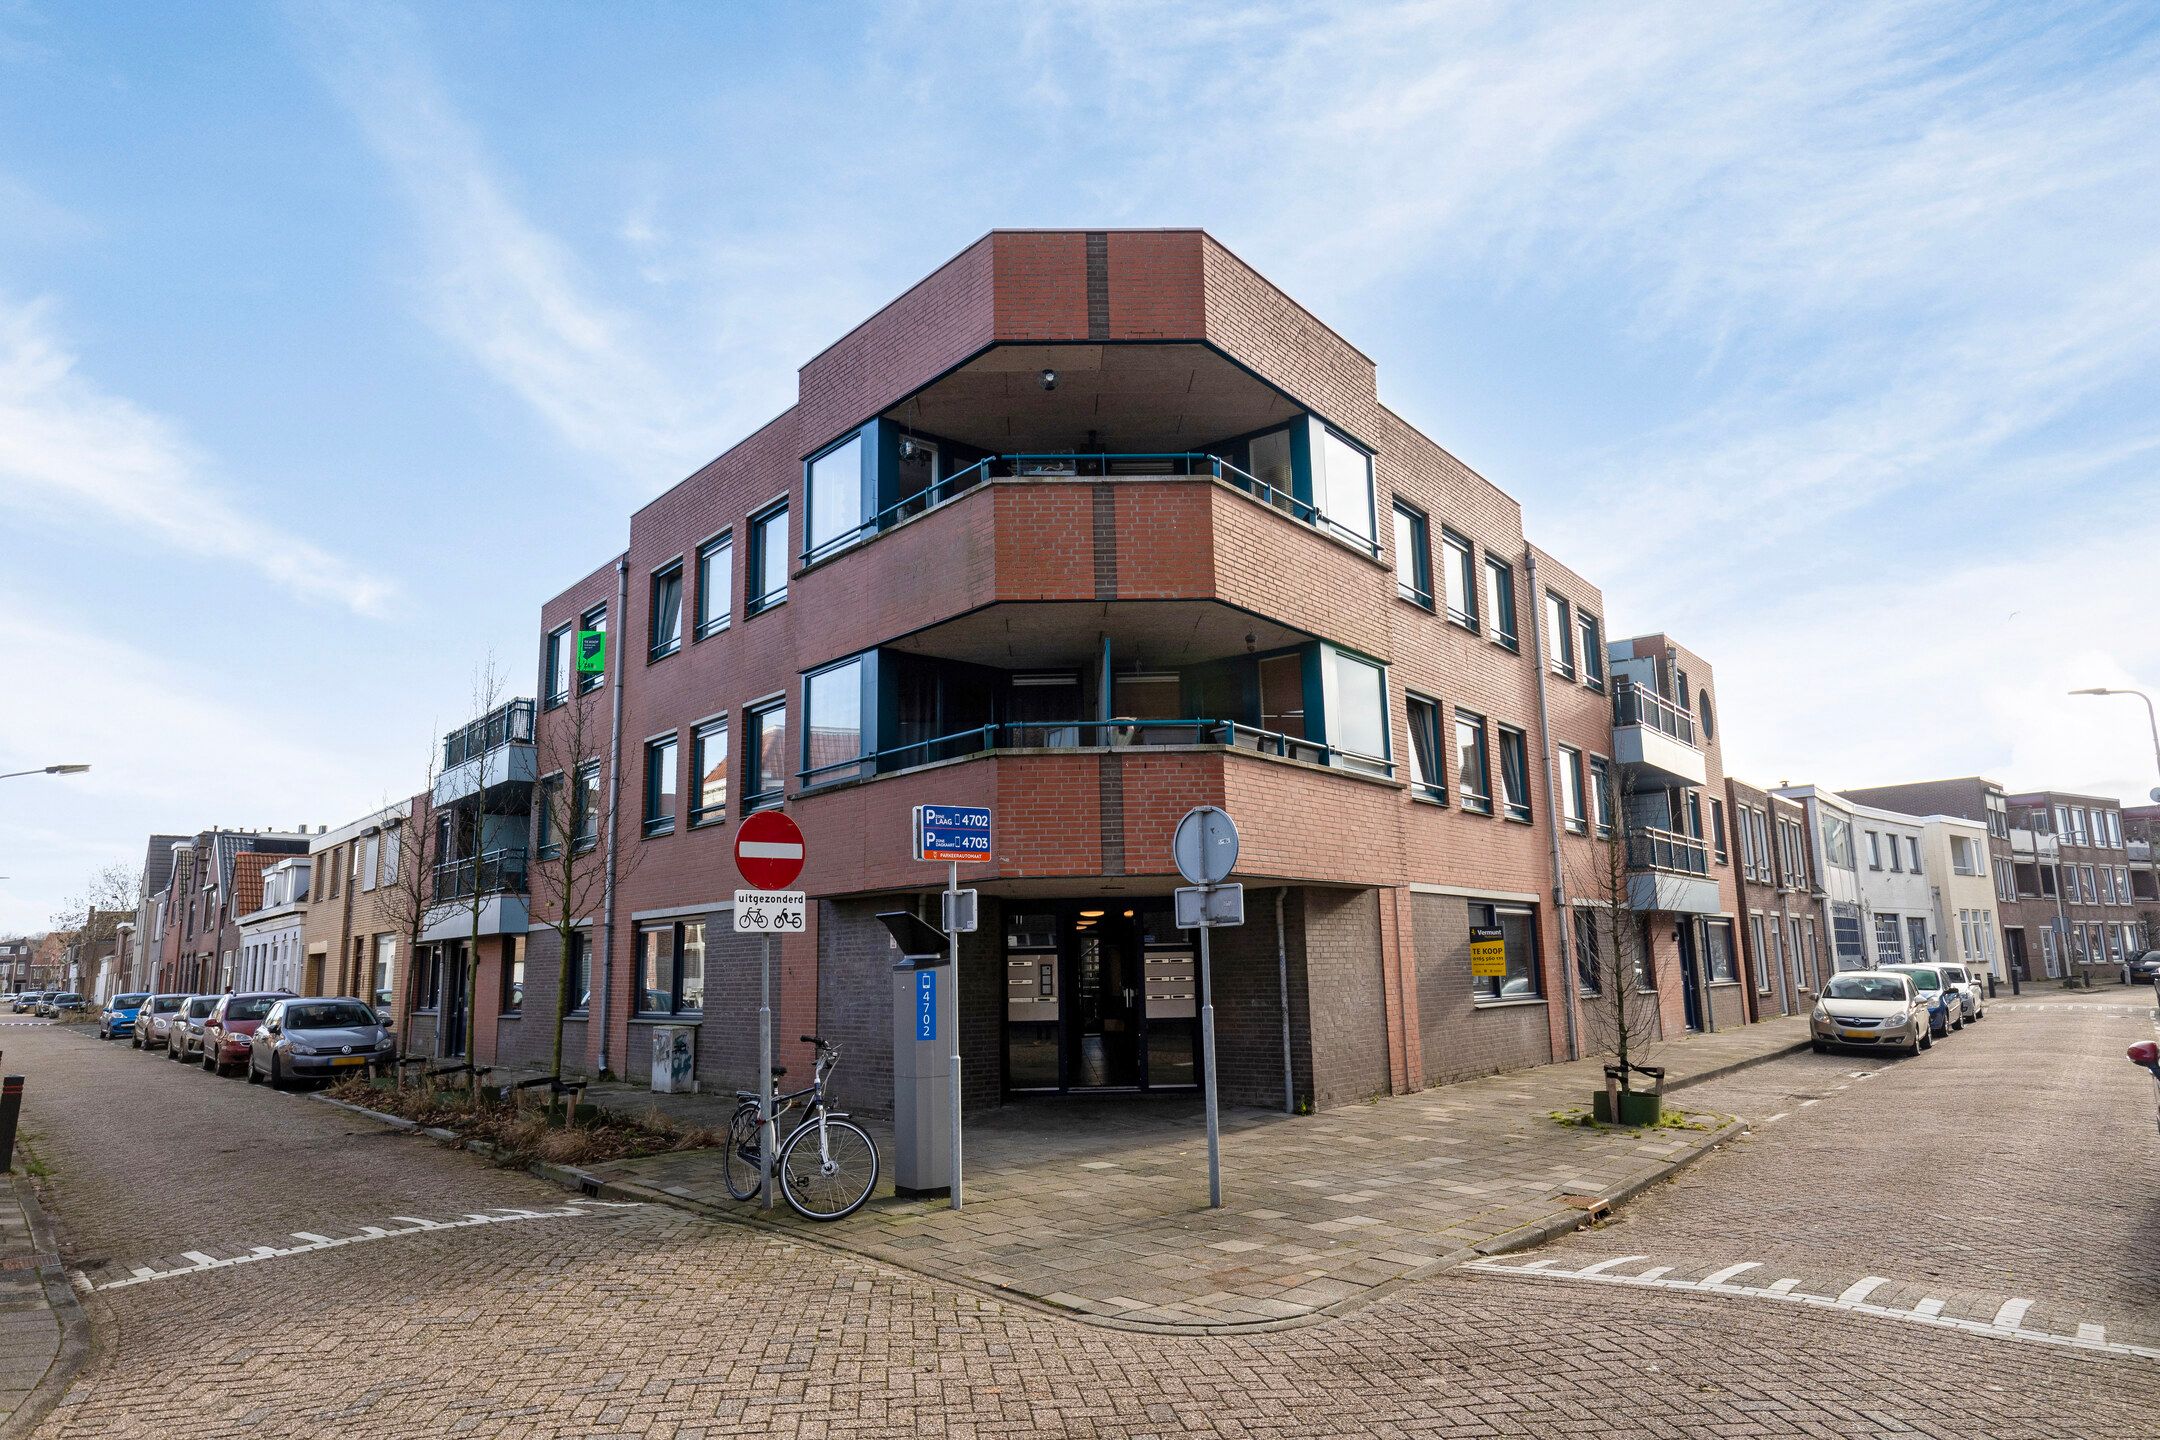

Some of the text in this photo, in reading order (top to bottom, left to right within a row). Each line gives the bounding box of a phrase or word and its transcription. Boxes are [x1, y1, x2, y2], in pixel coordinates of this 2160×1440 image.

[926, 809, 935, 824] P
[962, 815, 988, 826] 4702
[926, 832, 935, 847] P
[962, 837, 988, 849] 4703
[739, 894, 803, 905] uitgezonderd
[922, 991, 930, 1036] 4702
